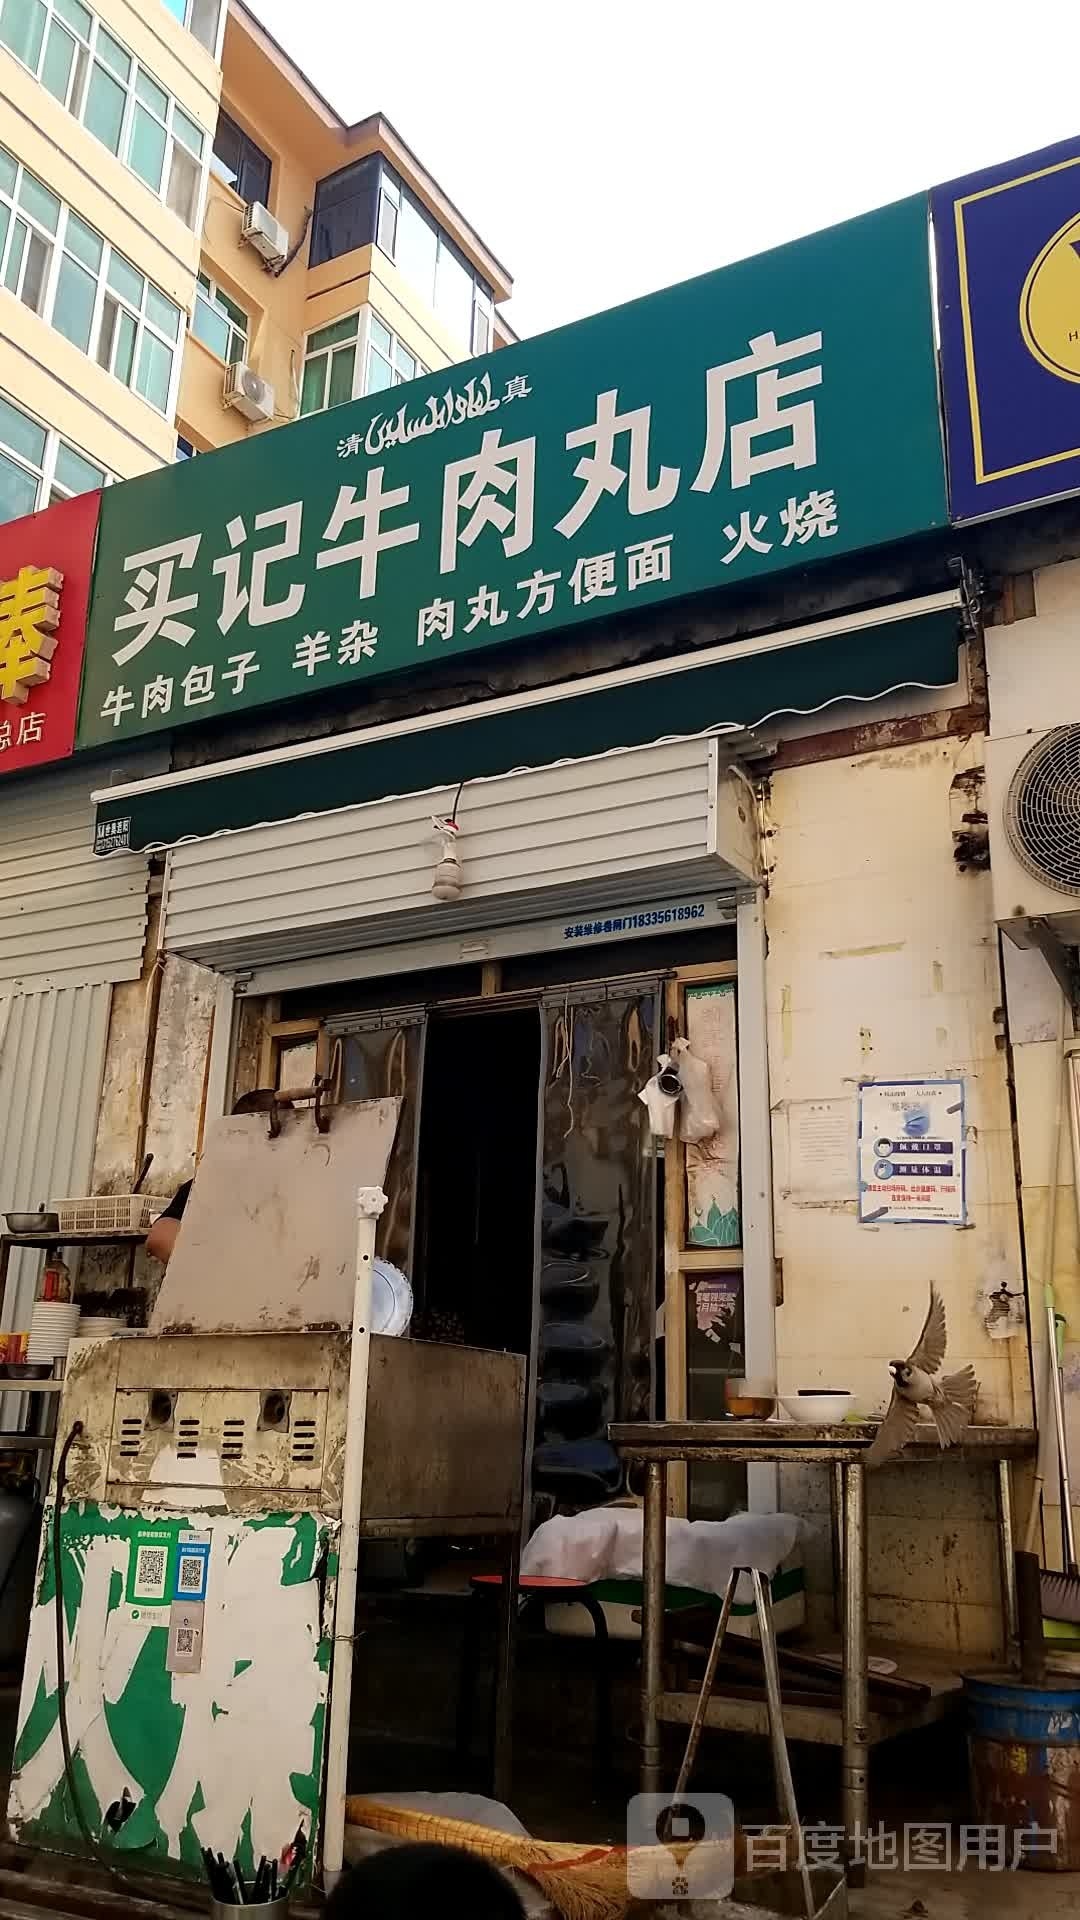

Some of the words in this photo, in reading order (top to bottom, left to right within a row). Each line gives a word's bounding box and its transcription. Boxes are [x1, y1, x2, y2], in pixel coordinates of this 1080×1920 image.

[501, 374, 532, 404] 真
[336, 433, 364, 458] 清
[111, 330, 823, 667] 买记牛肉丸店
[719, 489, 839, 566] 火烧
[416, 534, 673, 646] 肉丸方便面
[292, 619, 379, 676] 羊杂
[100, 650, 260, 727] 牛肉包子
